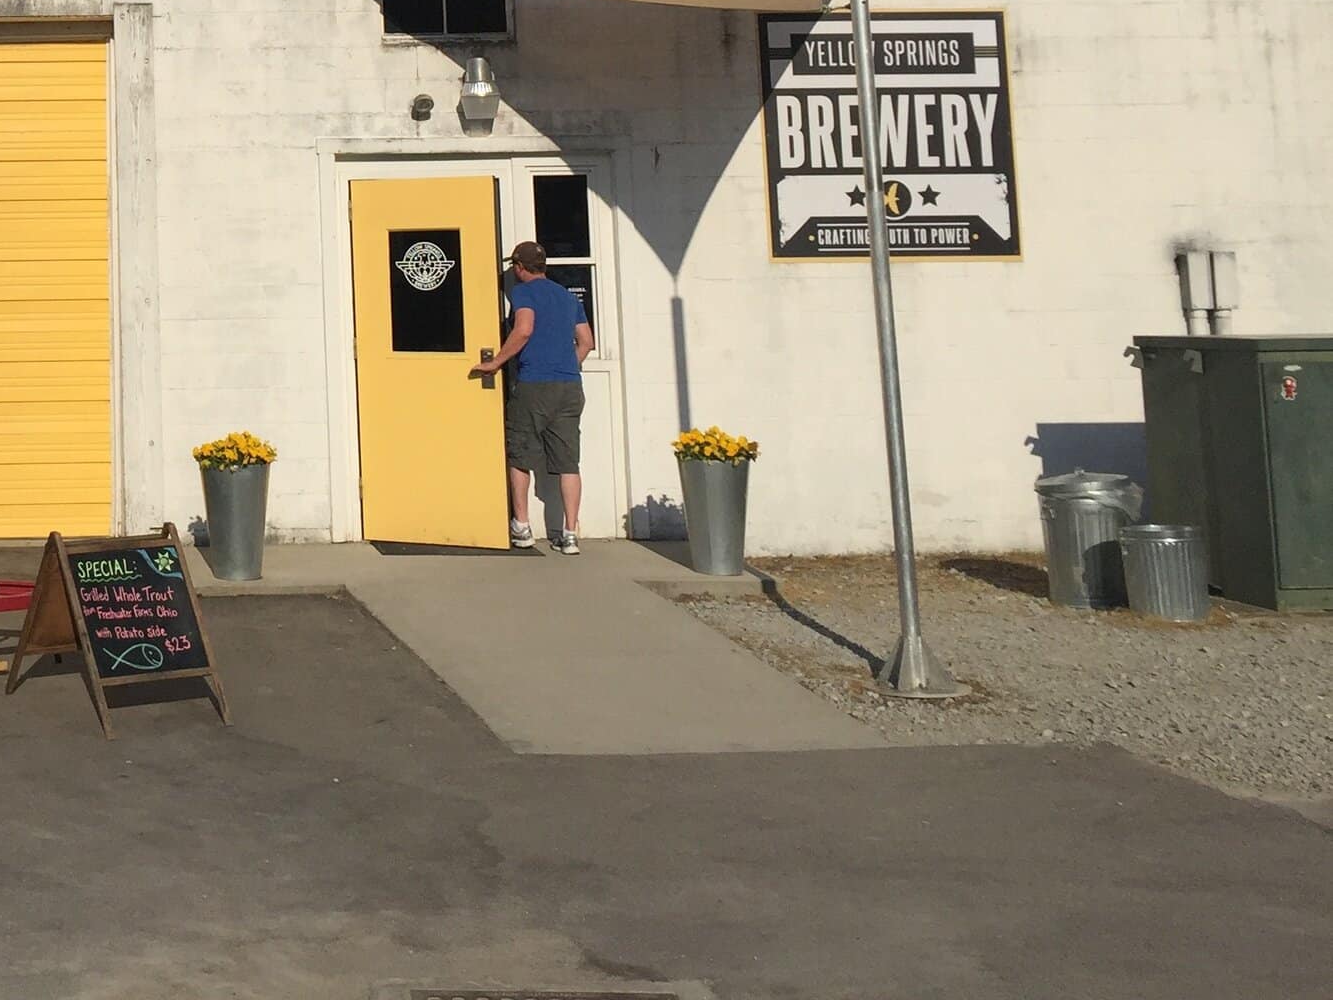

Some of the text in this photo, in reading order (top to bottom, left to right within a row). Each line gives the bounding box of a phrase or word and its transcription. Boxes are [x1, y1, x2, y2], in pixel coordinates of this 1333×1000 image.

[805, 39, 960, 67] YELLO SPRINGS
[776, 93, 998, 169] BREWERY
[887, 228, 910, 245] UTH
[913, 228, 927, 244] TO
[931, 227, 970, 244] POWER
[77, 558, 138, 578] SPECIAL:
[80, 585, 174, 602] Grilled Whole Trout
[156, 605, 178, 618] Ohio
[114, 626, 144, 639] Potato
[147, 625, 168, 638] side
[165, 635, 191, 655] $23
